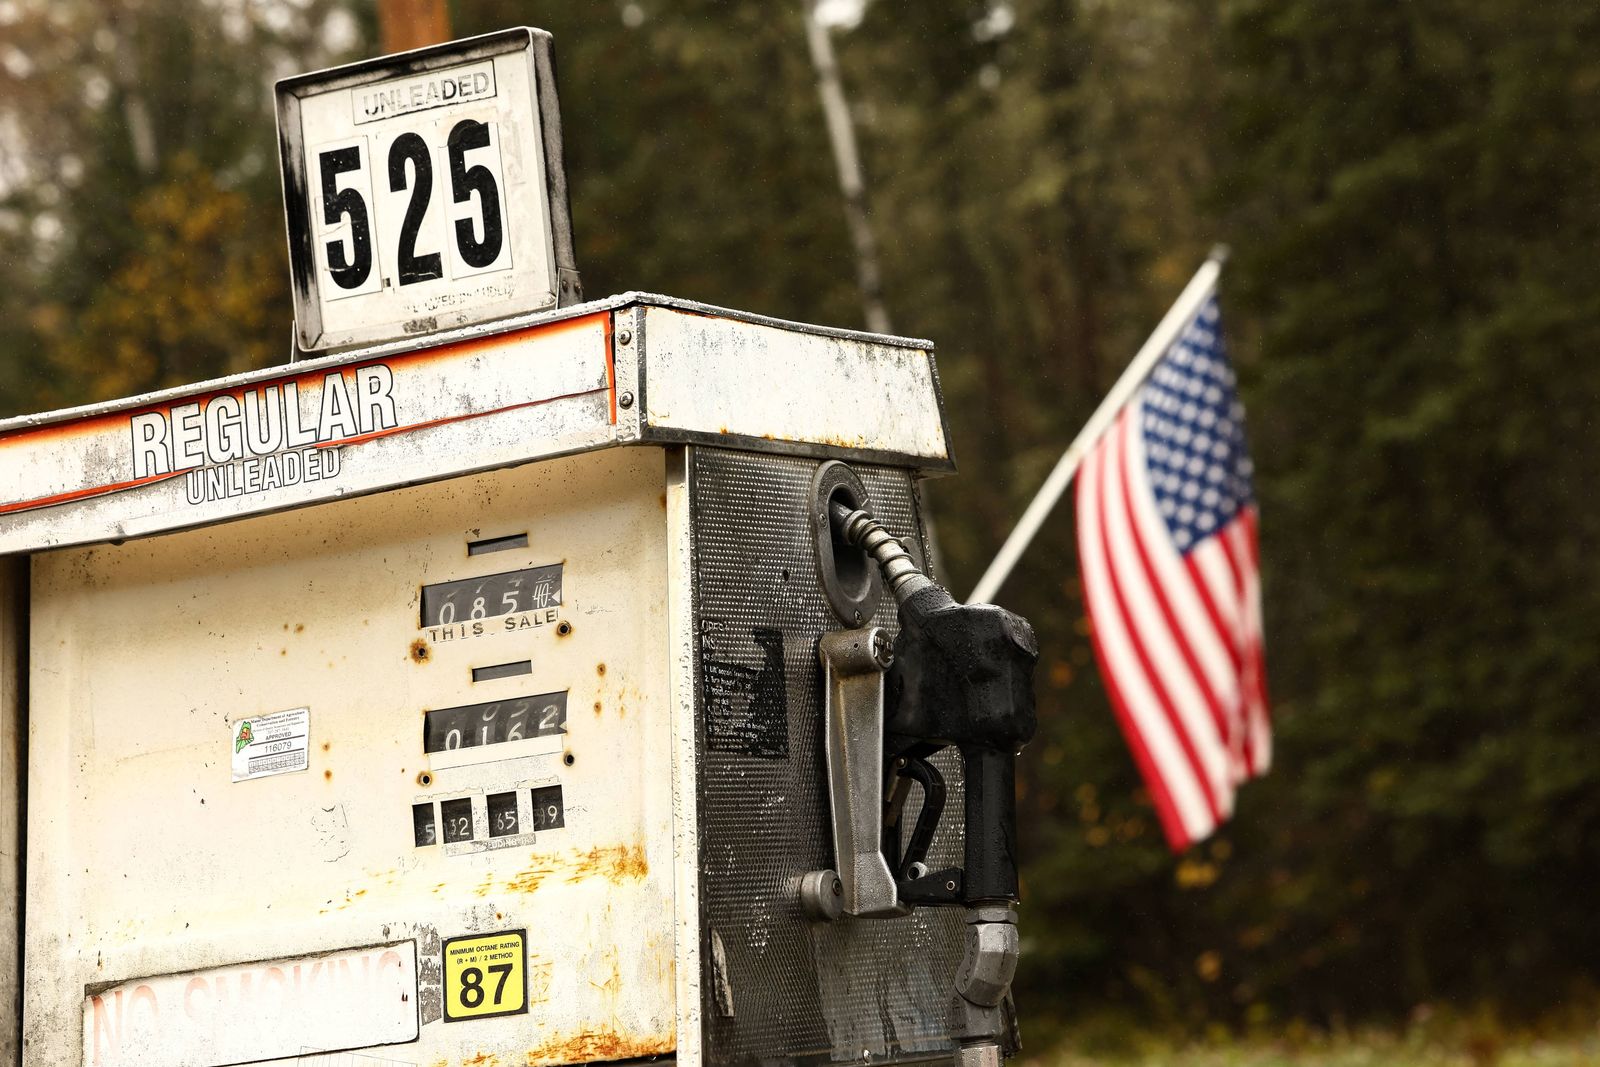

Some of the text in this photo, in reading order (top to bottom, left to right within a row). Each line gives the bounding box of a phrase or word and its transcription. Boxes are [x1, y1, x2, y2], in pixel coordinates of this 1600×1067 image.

[363, 71, 490, 115] UNLEADED
[130, 363, 398, 480] REGULAR
[185, 446, 341, 505] UNLEADED
[429, 609, 557, 642] THIS SALE
[265, 731, 292, 740] APPROVED
[265, 741, 292, 753] 116079
[450, 941, 520, 955] MINIMUM OCTANE RATING
[489, 952, 514, 960] METHOD
[460, 963, 513, 1009] 87
